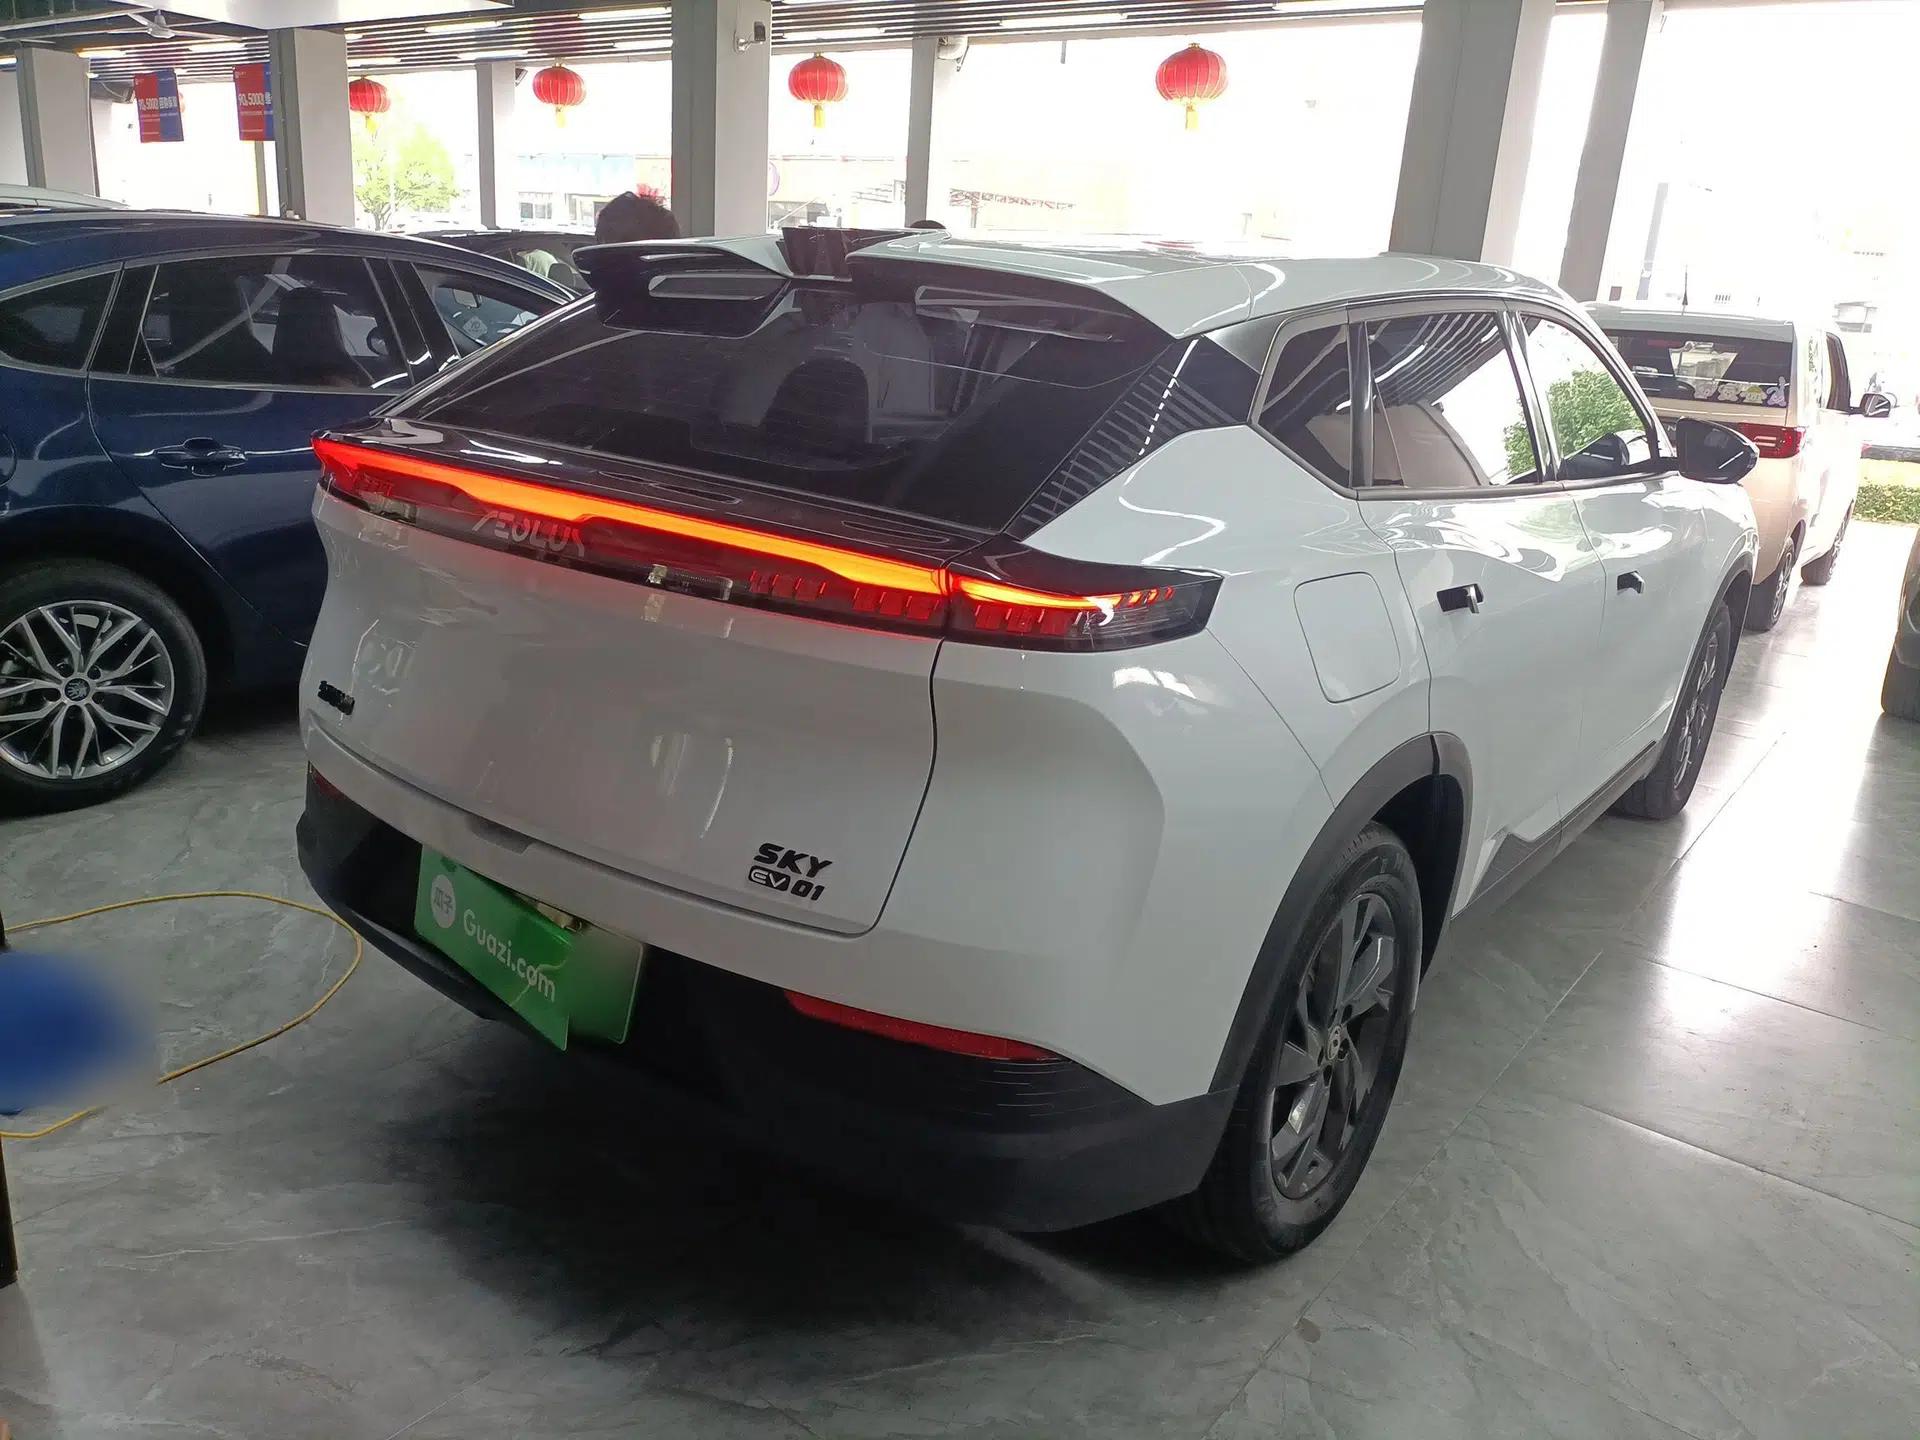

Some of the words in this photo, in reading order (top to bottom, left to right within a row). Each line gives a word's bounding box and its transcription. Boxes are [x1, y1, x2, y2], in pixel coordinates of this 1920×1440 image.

[753, 842, 833, 878] SKY
[749, 867, 789, 890] EV
[790, 879, 826, 901] 01
